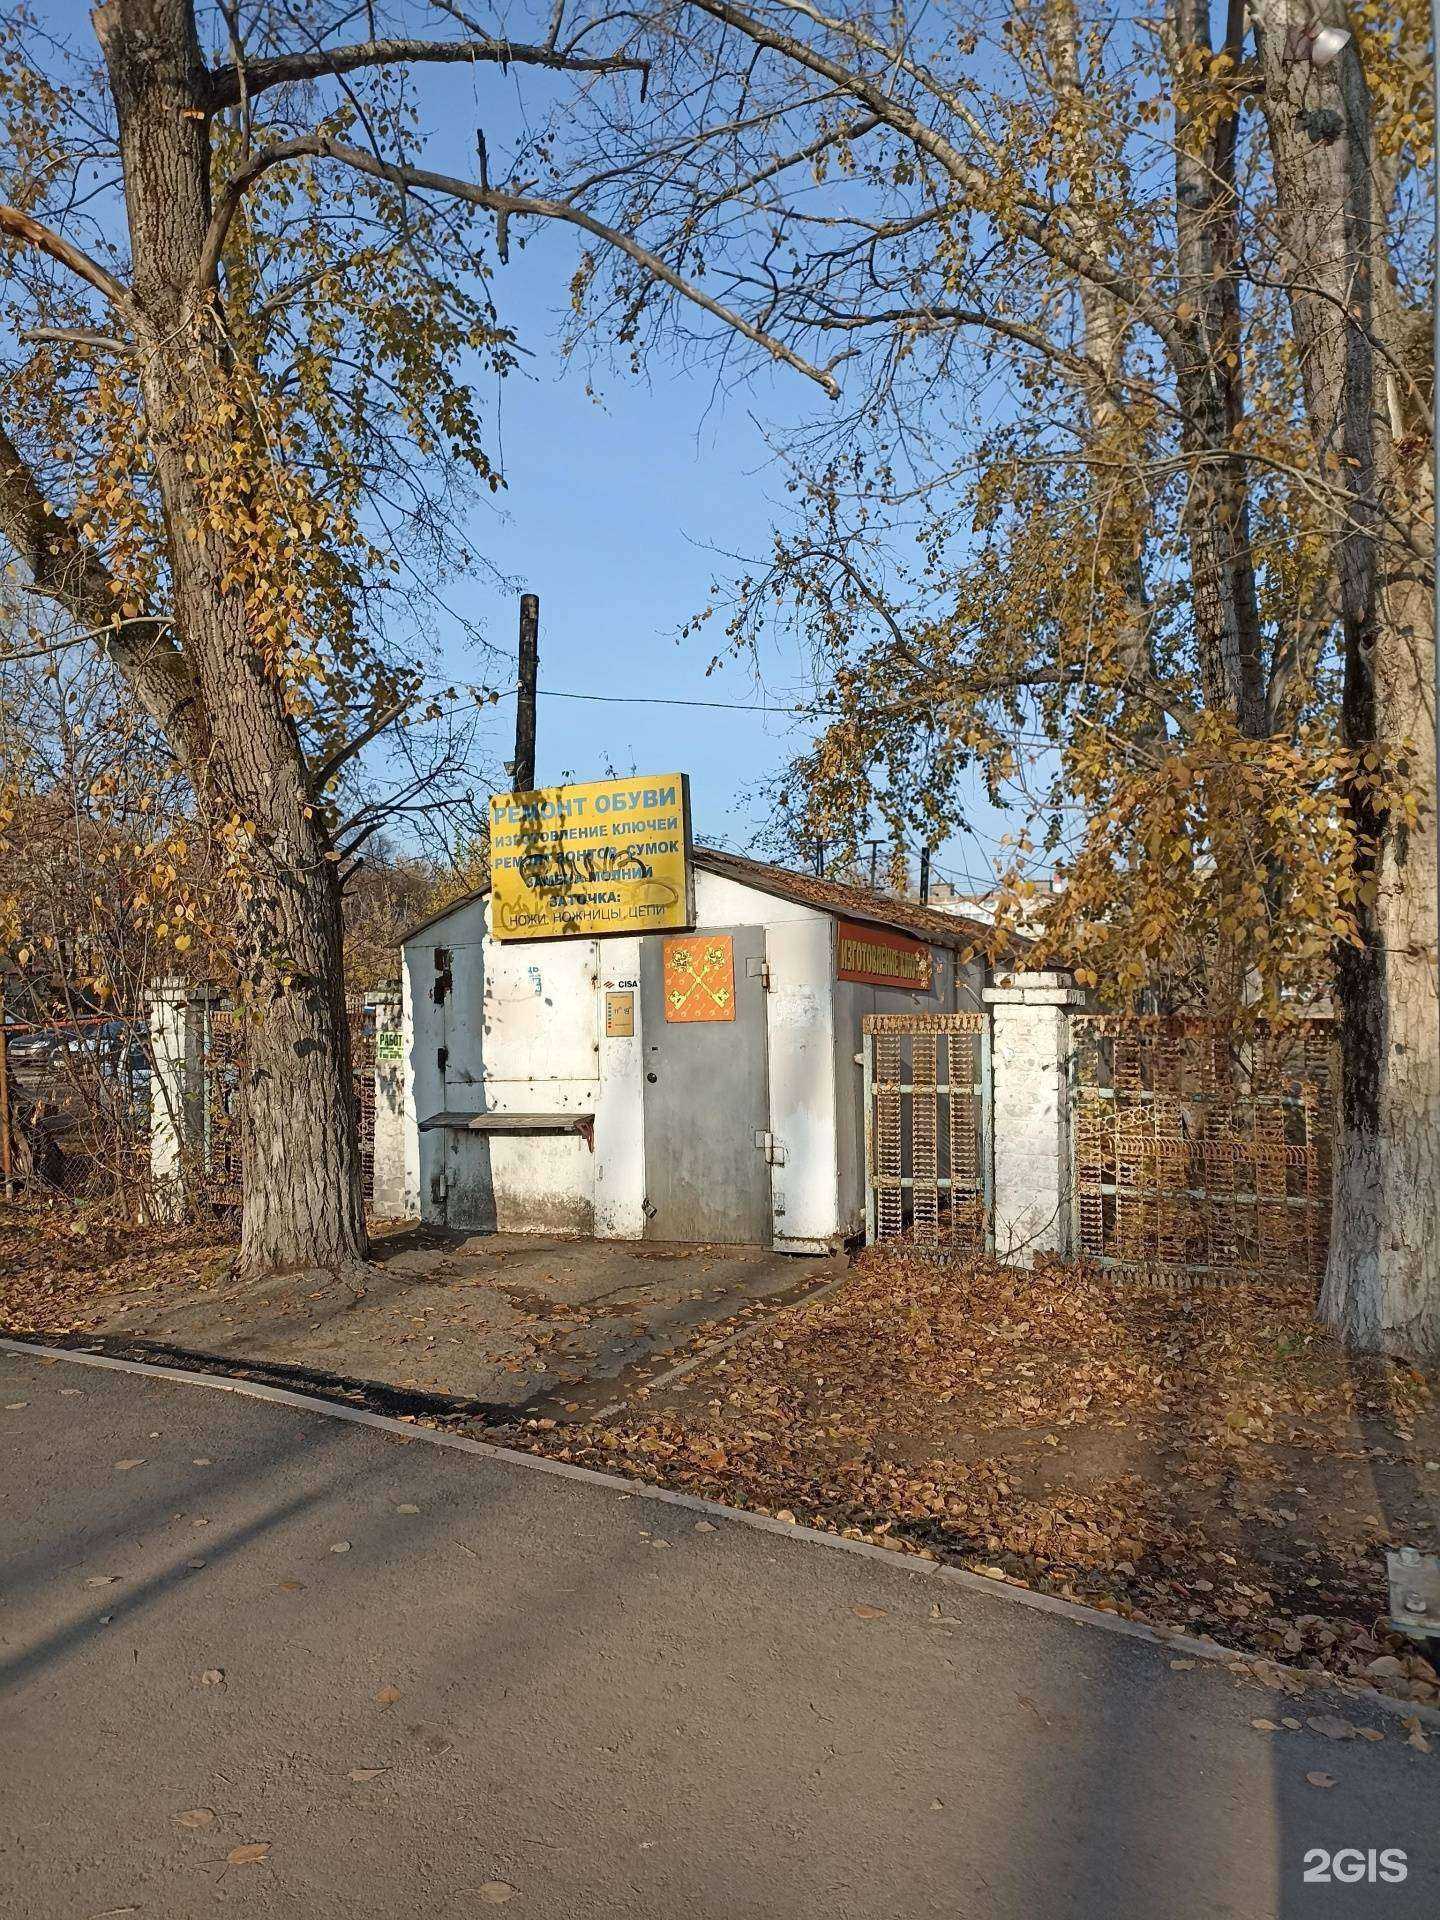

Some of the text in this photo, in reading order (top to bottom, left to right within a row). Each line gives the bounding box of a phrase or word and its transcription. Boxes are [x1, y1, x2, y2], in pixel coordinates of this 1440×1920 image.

[494, 787, 676, 825] РЕМОНТ ОБУВИ
[612, 816, 678, 836] КЛЮЧЕЙ
[495, 852, 552, 869] РЕМТ
[626, 840, 680, 858] СУМОК
[527, 872, 585, 888] ЗАМЕА
[548, 891, 621, 908] ЗАТОЧКА:
[628, 904, 665, 918] ЦЕПИ
[841, 938, 899, 977] ИЗГОТОВЛЕНИЕ
[618, 980, 638, 988] CISA
